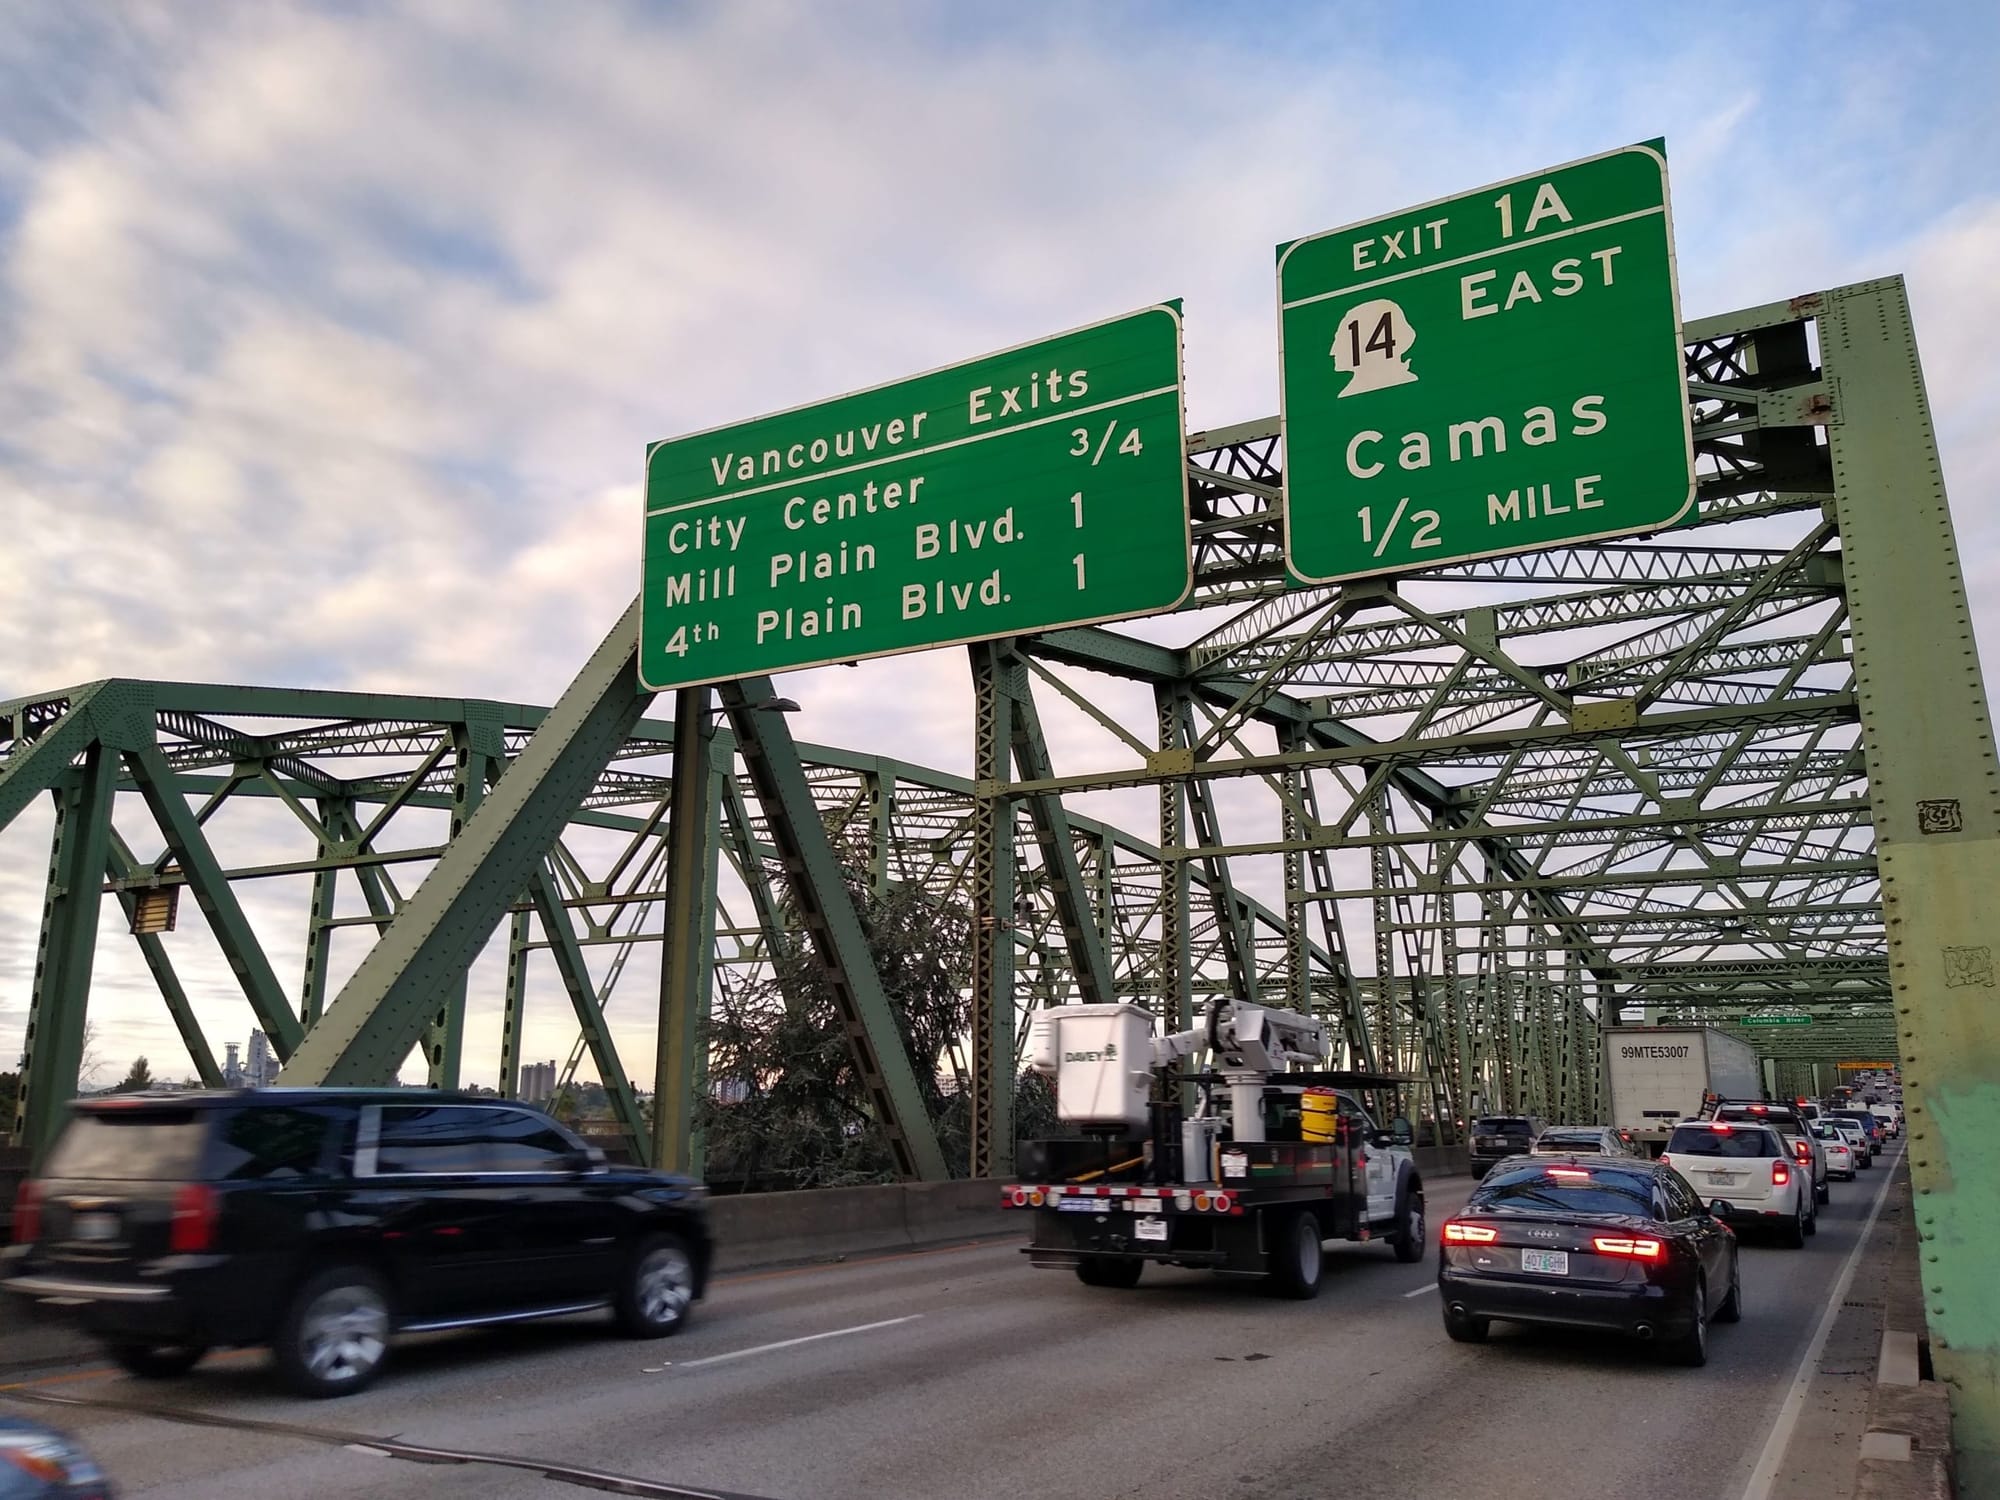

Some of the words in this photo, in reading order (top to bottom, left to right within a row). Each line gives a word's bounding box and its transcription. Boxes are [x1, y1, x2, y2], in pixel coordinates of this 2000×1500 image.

[1353, 218, 1449, 272] EXIT
[1494, 182, 1573, 239] 1A
[1460, 246, 1622, 321] EAST
[1347, 311, 1396, 367] 14
[711, 411, 928, 486] Vancouver
[969, 368, 1089, 425] Exits
[1346, 395, 1607, 479] Camas
[668, 515, 747, 554] City
[783, 476, 925, 530] Center
[1069, 419, 1143, 466] 3/4
[1357, 497, 1442, 557] 1/2
[1487, 474, 1604, 525] MILE
[666, 565, 735, 608] Mill
[770, 541, 875, 588] Plain
[916, 507, 1024, 560] Blvd.
[1070, 491, 1084, 529] 1
[665, 620, 720, 658] 4th
[757, 596, 862, 645] Plain
[902, 569, 1011, 620] Blvd.
[1072, 553, 1086, 590] 1
[1064, 1051, 1103, 1063] DAVEY
[1621, 1046, 1689, 1059] 99MTE53007
